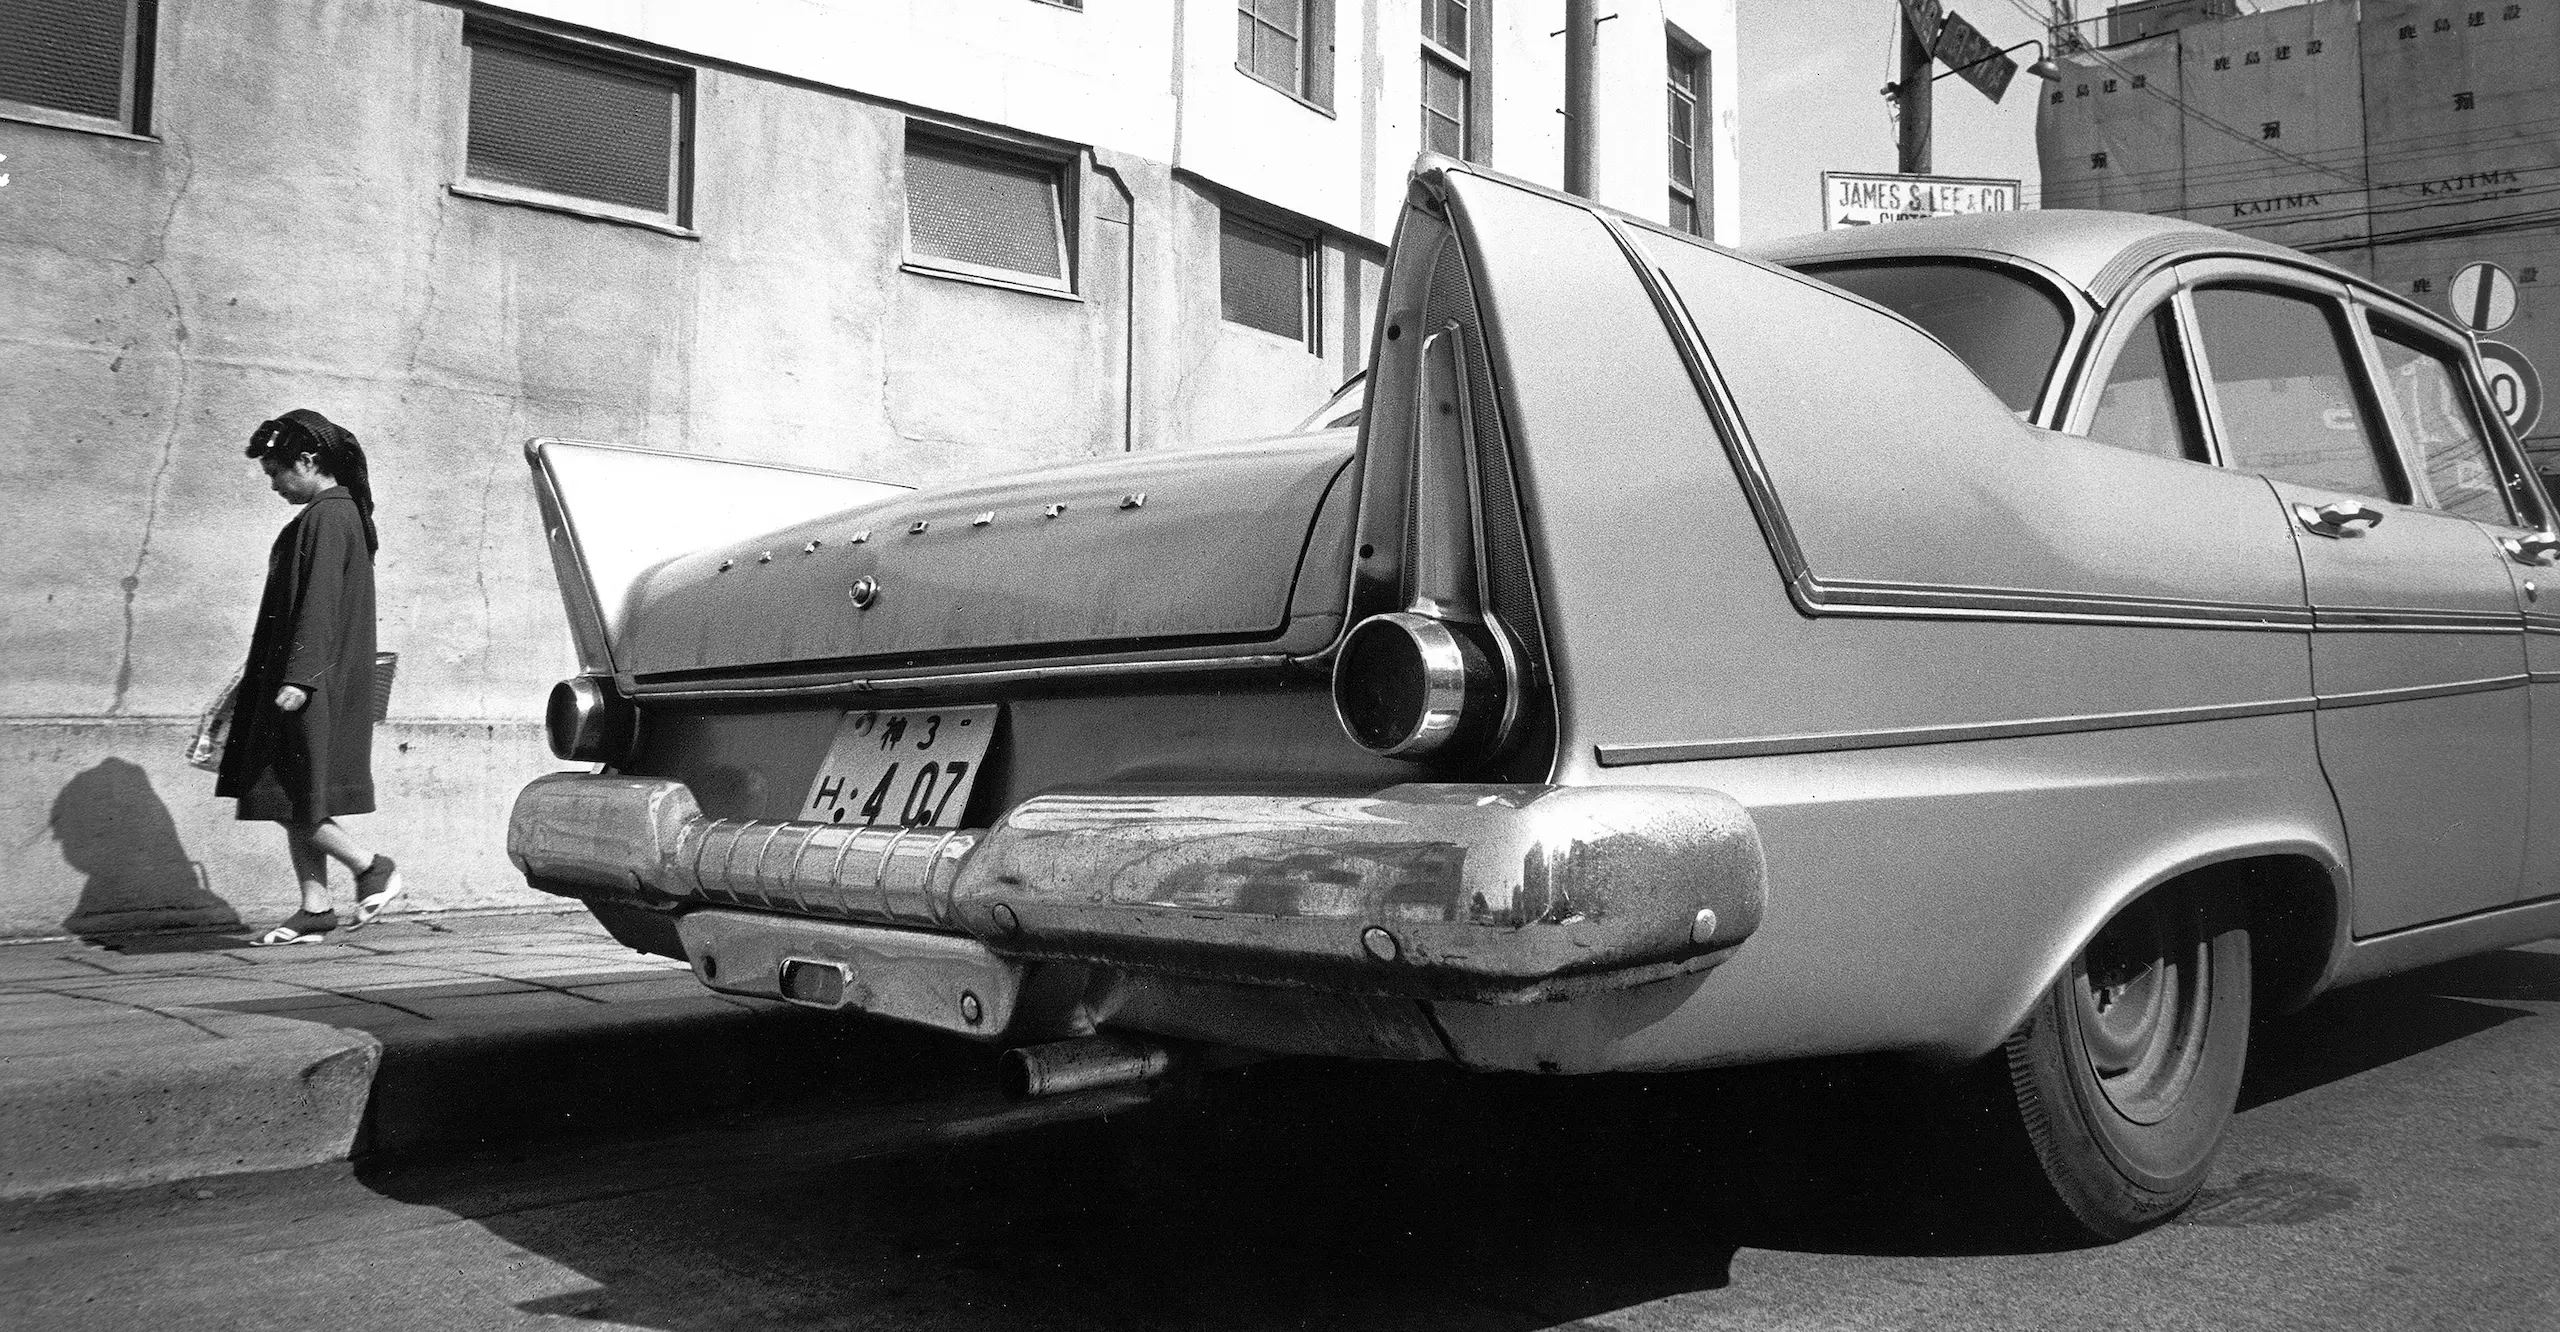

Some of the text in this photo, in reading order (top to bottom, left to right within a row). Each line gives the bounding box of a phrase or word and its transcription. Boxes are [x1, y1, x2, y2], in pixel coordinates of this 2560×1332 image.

[1839, 181, 1901, 210] JAMES
[1928, 186, 1964, 214] LEE
[2421, 170, 2518, 197] KAJIMA
[2232, 194, 2321, 217] KAJIMA
[916, 714, 941, 750] 3
